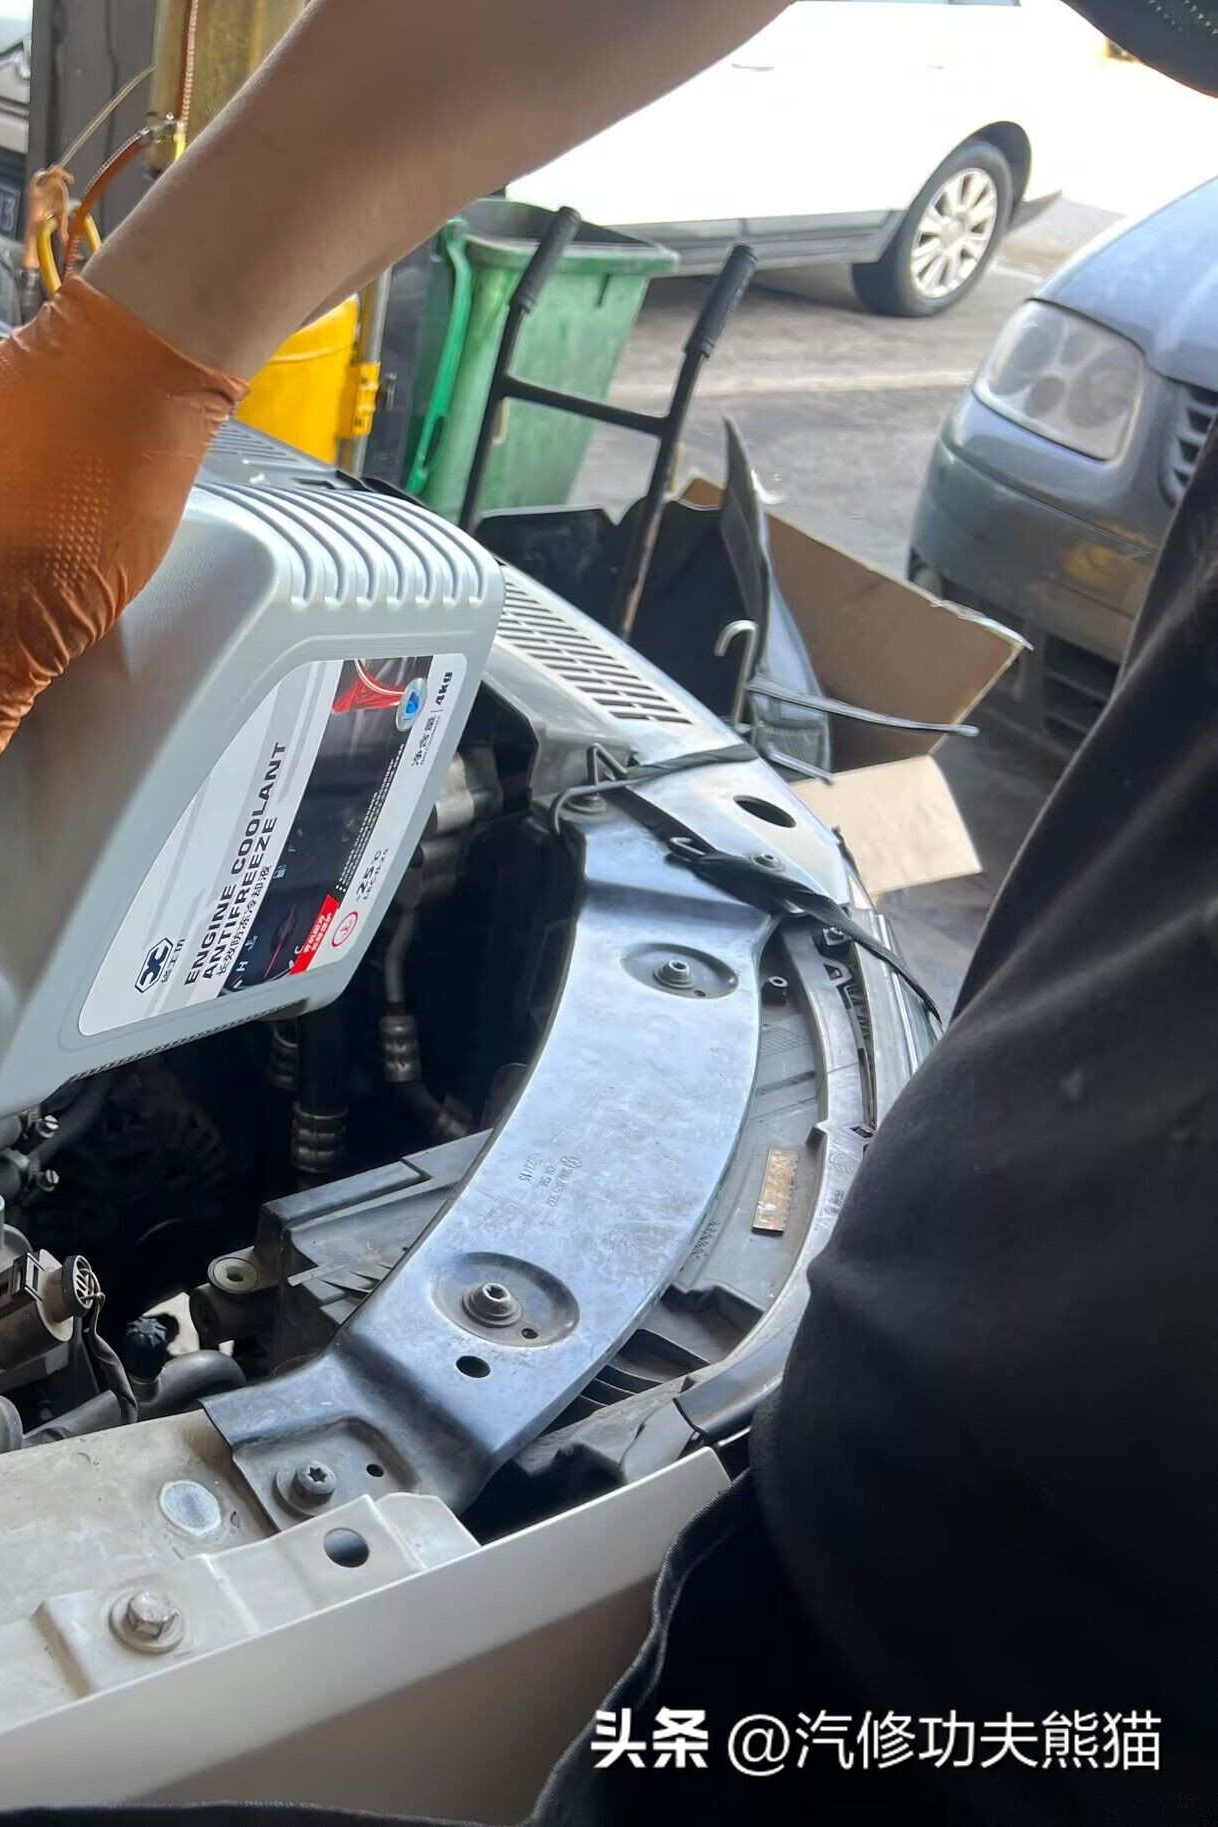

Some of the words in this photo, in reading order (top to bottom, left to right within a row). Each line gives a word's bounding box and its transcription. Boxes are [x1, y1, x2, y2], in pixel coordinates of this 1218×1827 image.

[435, 671, 453, 706] 4kg
[183, 884, 236, 986] ENGINE
[231, 742, 287, 875] COOLANT
[202, 816, 278, 980] ANTIFREEZE
[216, 865, 272, 977] 长效防冻冷却液
